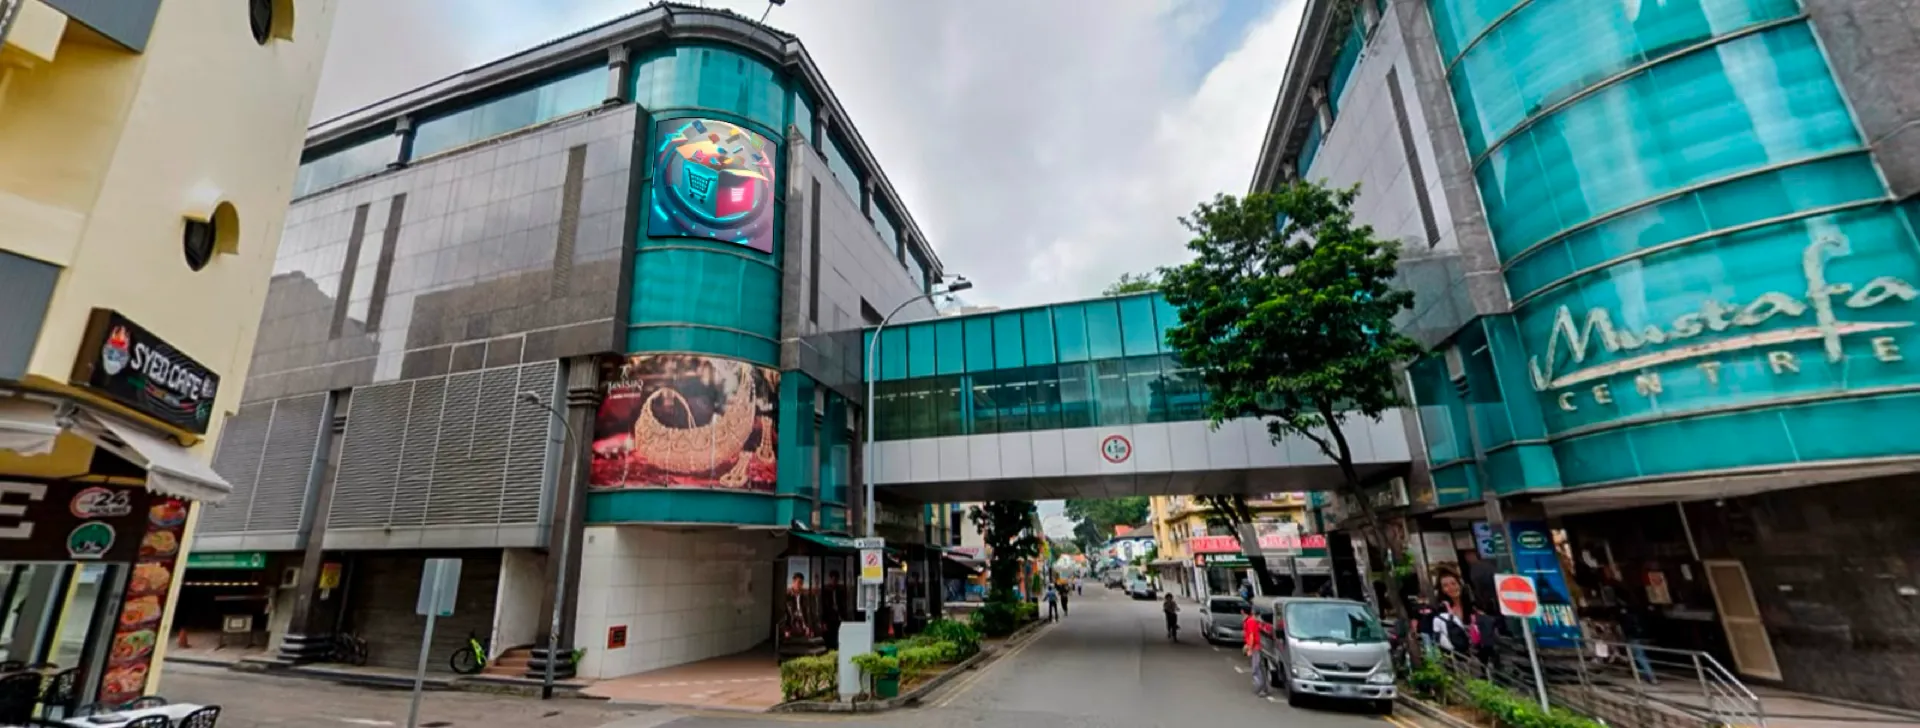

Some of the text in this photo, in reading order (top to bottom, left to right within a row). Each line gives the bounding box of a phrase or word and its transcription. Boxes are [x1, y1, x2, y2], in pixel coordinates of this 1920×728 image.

[1529, 234, 1919, 391] Mustafa
[130, 342, 170, 384] SYED
[167, 364, 203, 401] CAFE
[1557, 335, 1904, 412] CENTRE
[94, 492, 127, 506] 24
